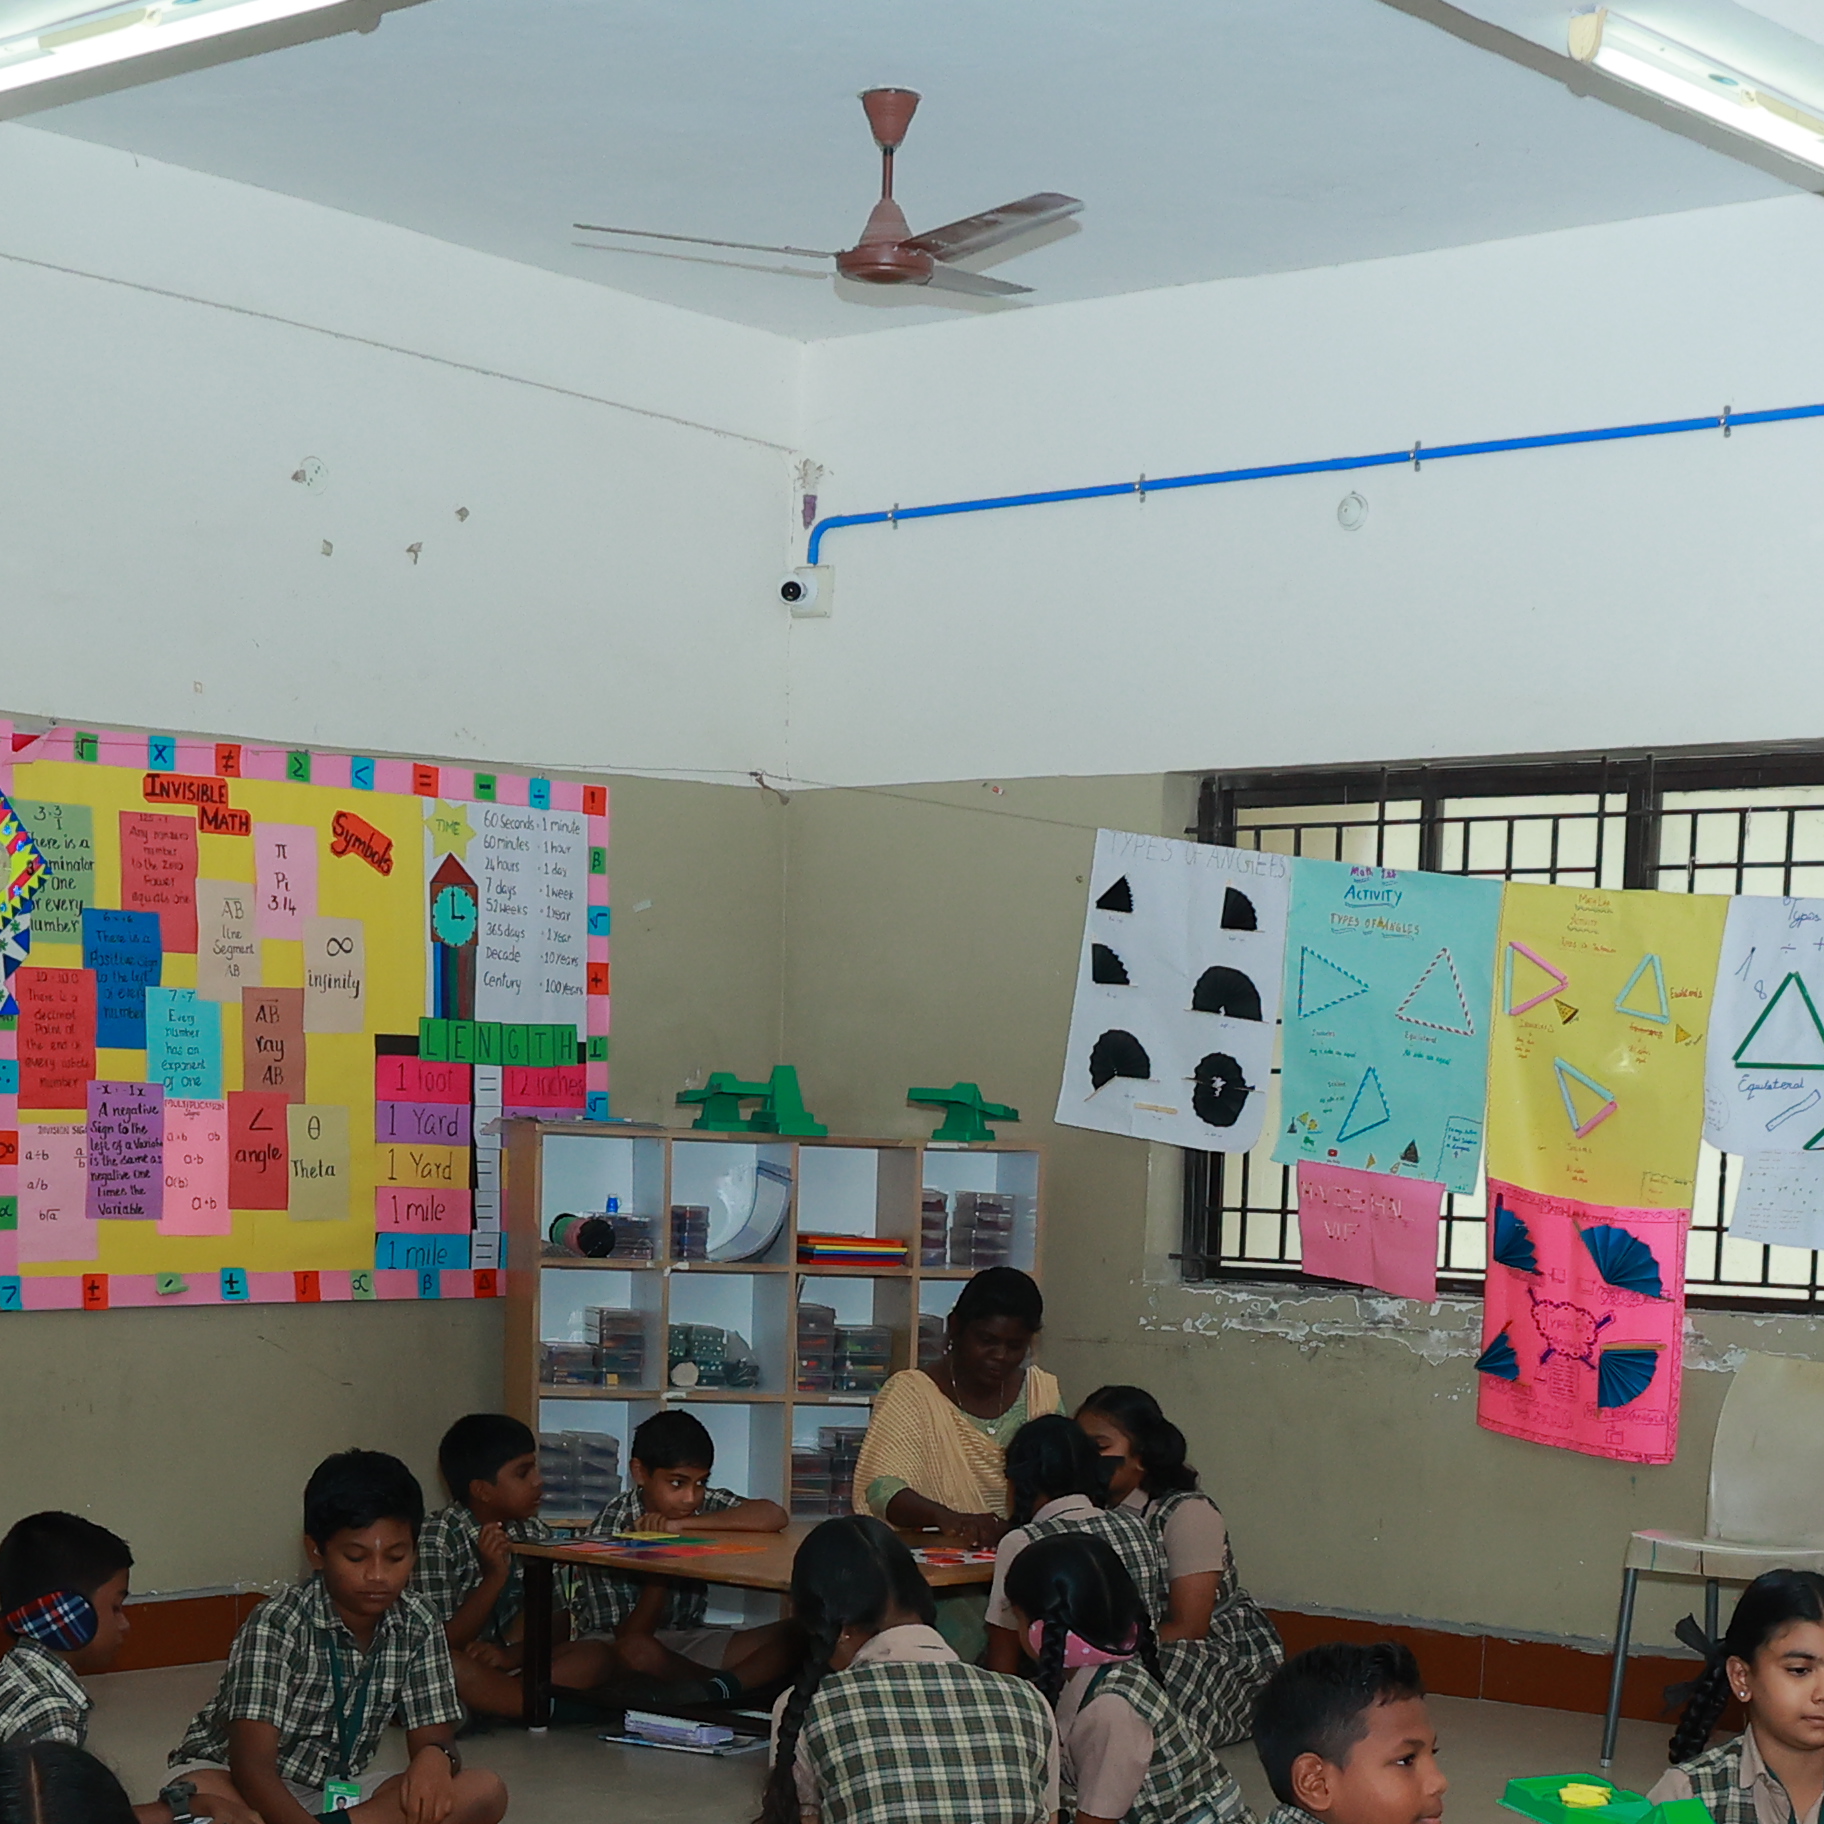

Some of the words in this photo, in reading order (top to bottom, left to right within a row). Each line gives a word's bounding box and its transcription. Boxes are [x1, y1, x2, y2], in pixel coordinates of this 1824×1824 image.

[145, 773, 226, 805] INVISIBLE
[200, 806, 250, 833] MATH
[332, 813, 393, 875] Symbols
[425, 1022, 573, 1061] LENGTH
[235, 1143, 282, 1173] angle
